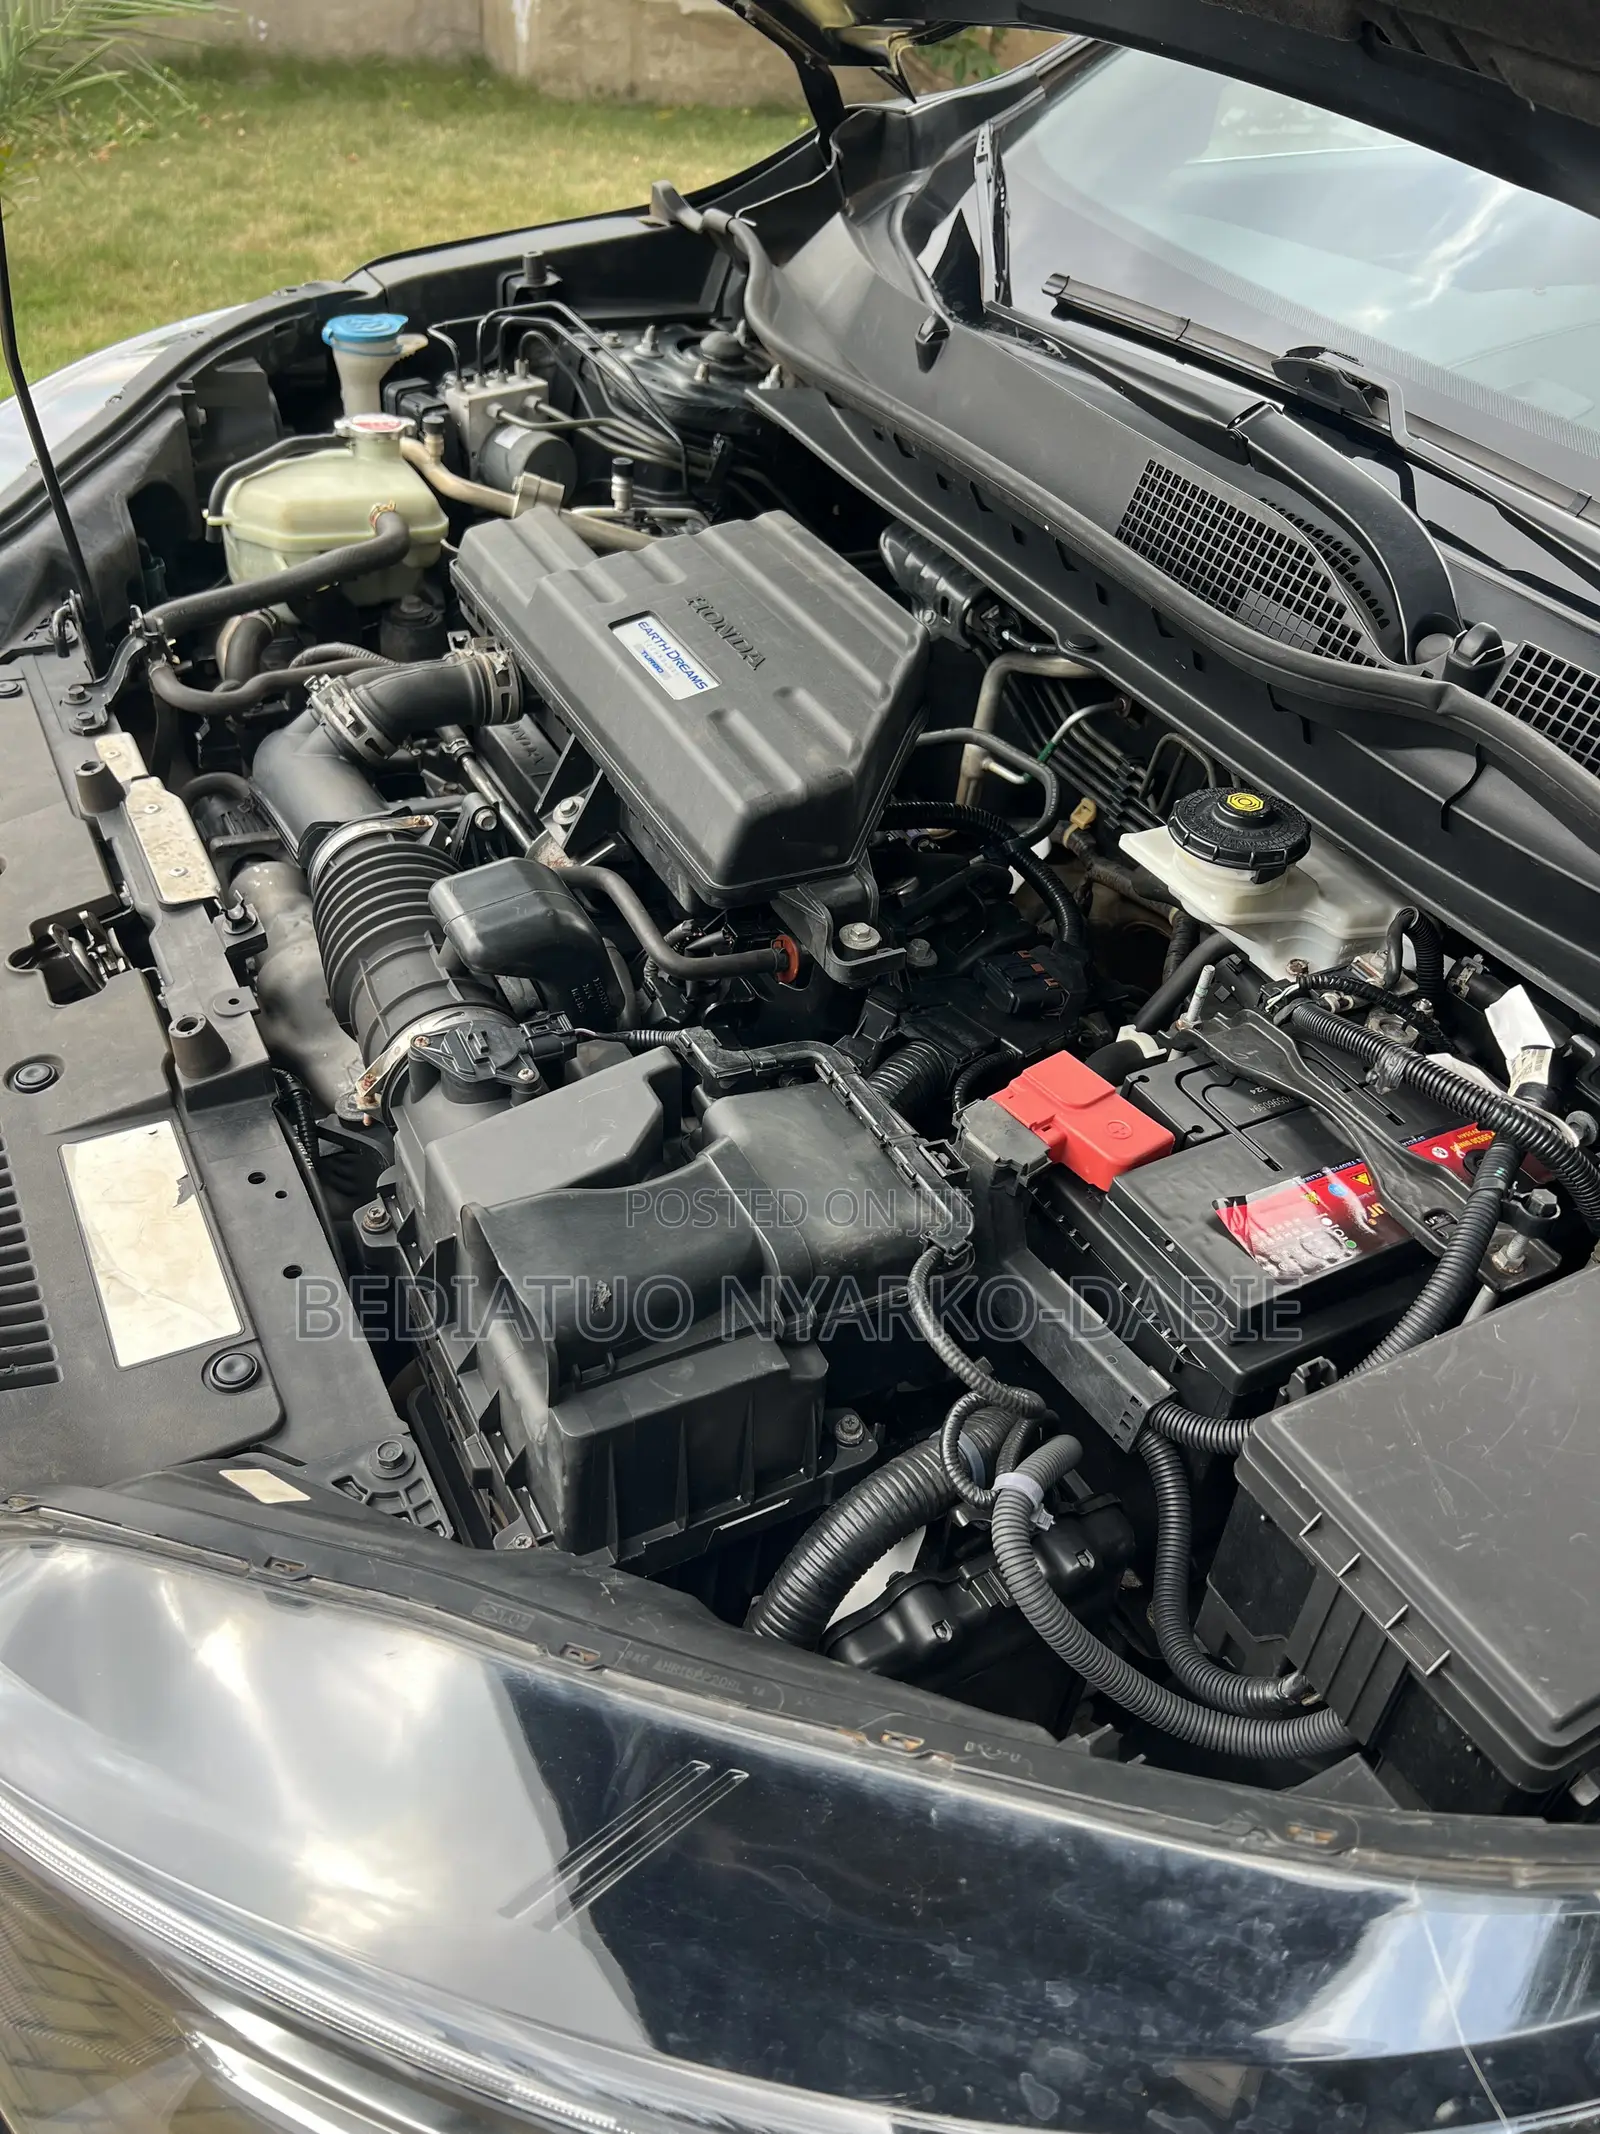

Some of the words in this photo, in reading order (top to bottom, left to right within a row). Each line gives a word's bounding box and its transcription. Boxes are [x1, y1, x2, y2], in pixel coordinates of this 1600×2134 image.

[638, 621, 671, 651] EARTH
[666, 650, 708, 690] DREAMS
[641, 650, 664, 673] TURBO
[683, 594, 766, 671] HONDA
